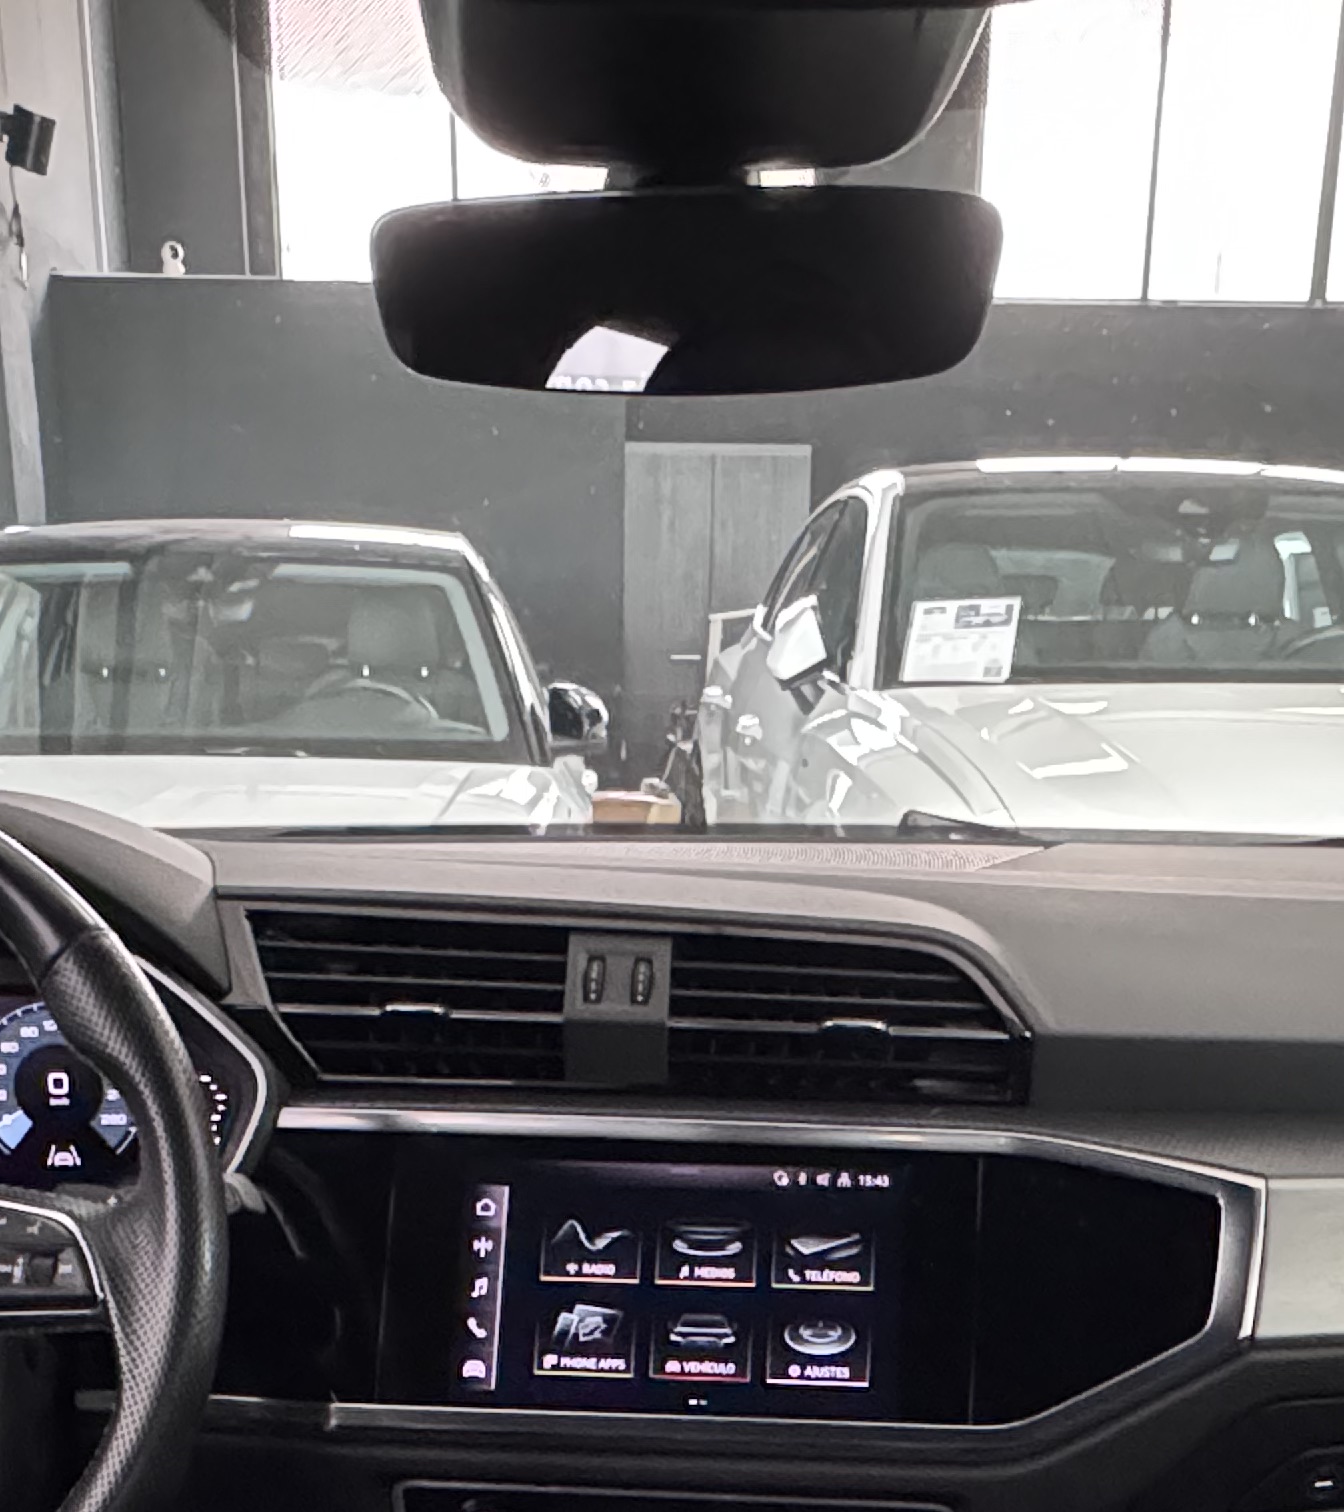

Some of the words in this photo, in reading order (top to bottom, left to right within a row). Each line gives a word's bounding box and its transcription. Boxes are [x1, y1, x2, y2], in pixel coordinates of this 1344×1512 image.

[47, 1071, 70, 1096] 0
[858, 1173, 890, 1188] 15:43
[582, 1262, 616, 1276] RADIO
[694, 1265, 736, 1280] MEDIOS
[560, 1357, 598, 1370] PHONE
[598, 1358, 626, 1371] APPS
[804, 1364, 851, 1380] AJUSTES
